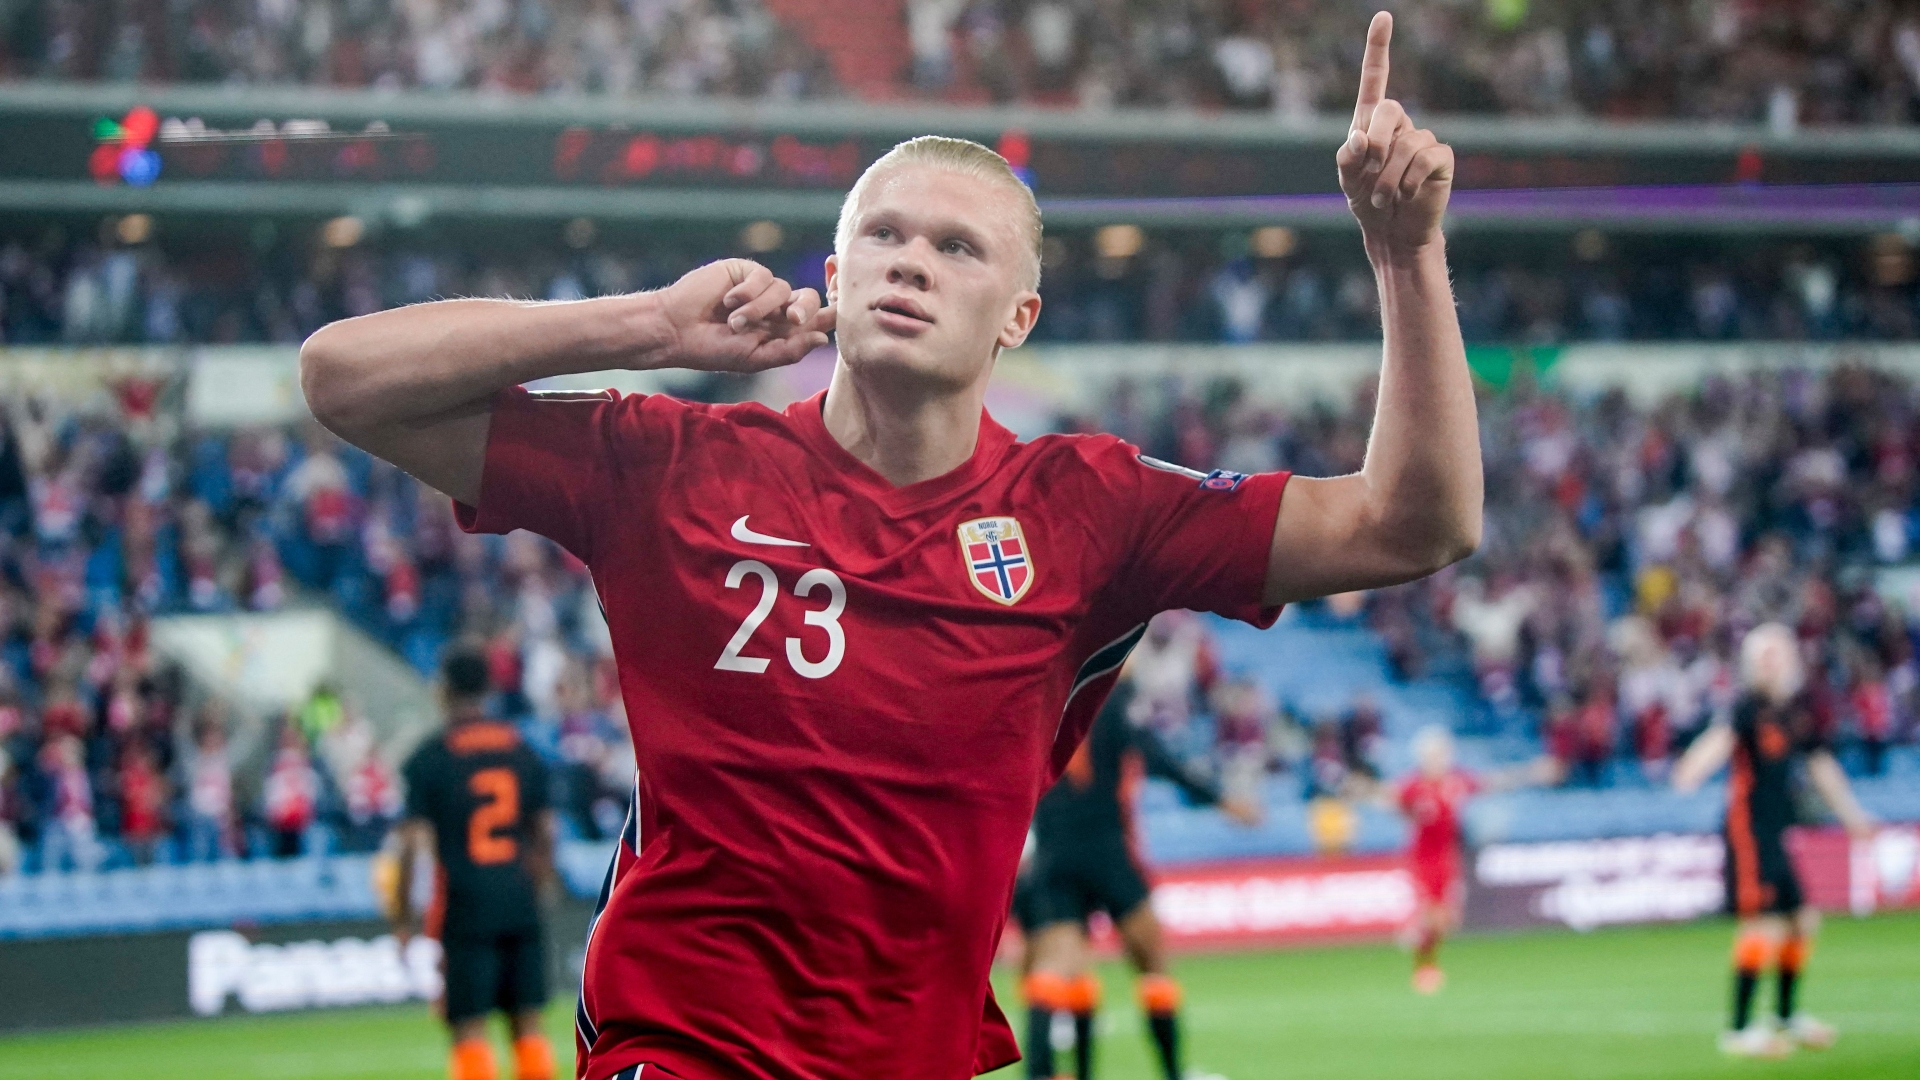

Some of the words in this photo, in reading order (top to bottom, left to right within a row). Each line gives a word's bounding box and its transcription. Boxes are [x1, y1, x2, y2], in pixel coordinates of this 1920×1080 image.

[978, 521, 998, 529] NORGE
[713, 559, 847, 679] 23
[468, 767, 519, 866] 2
